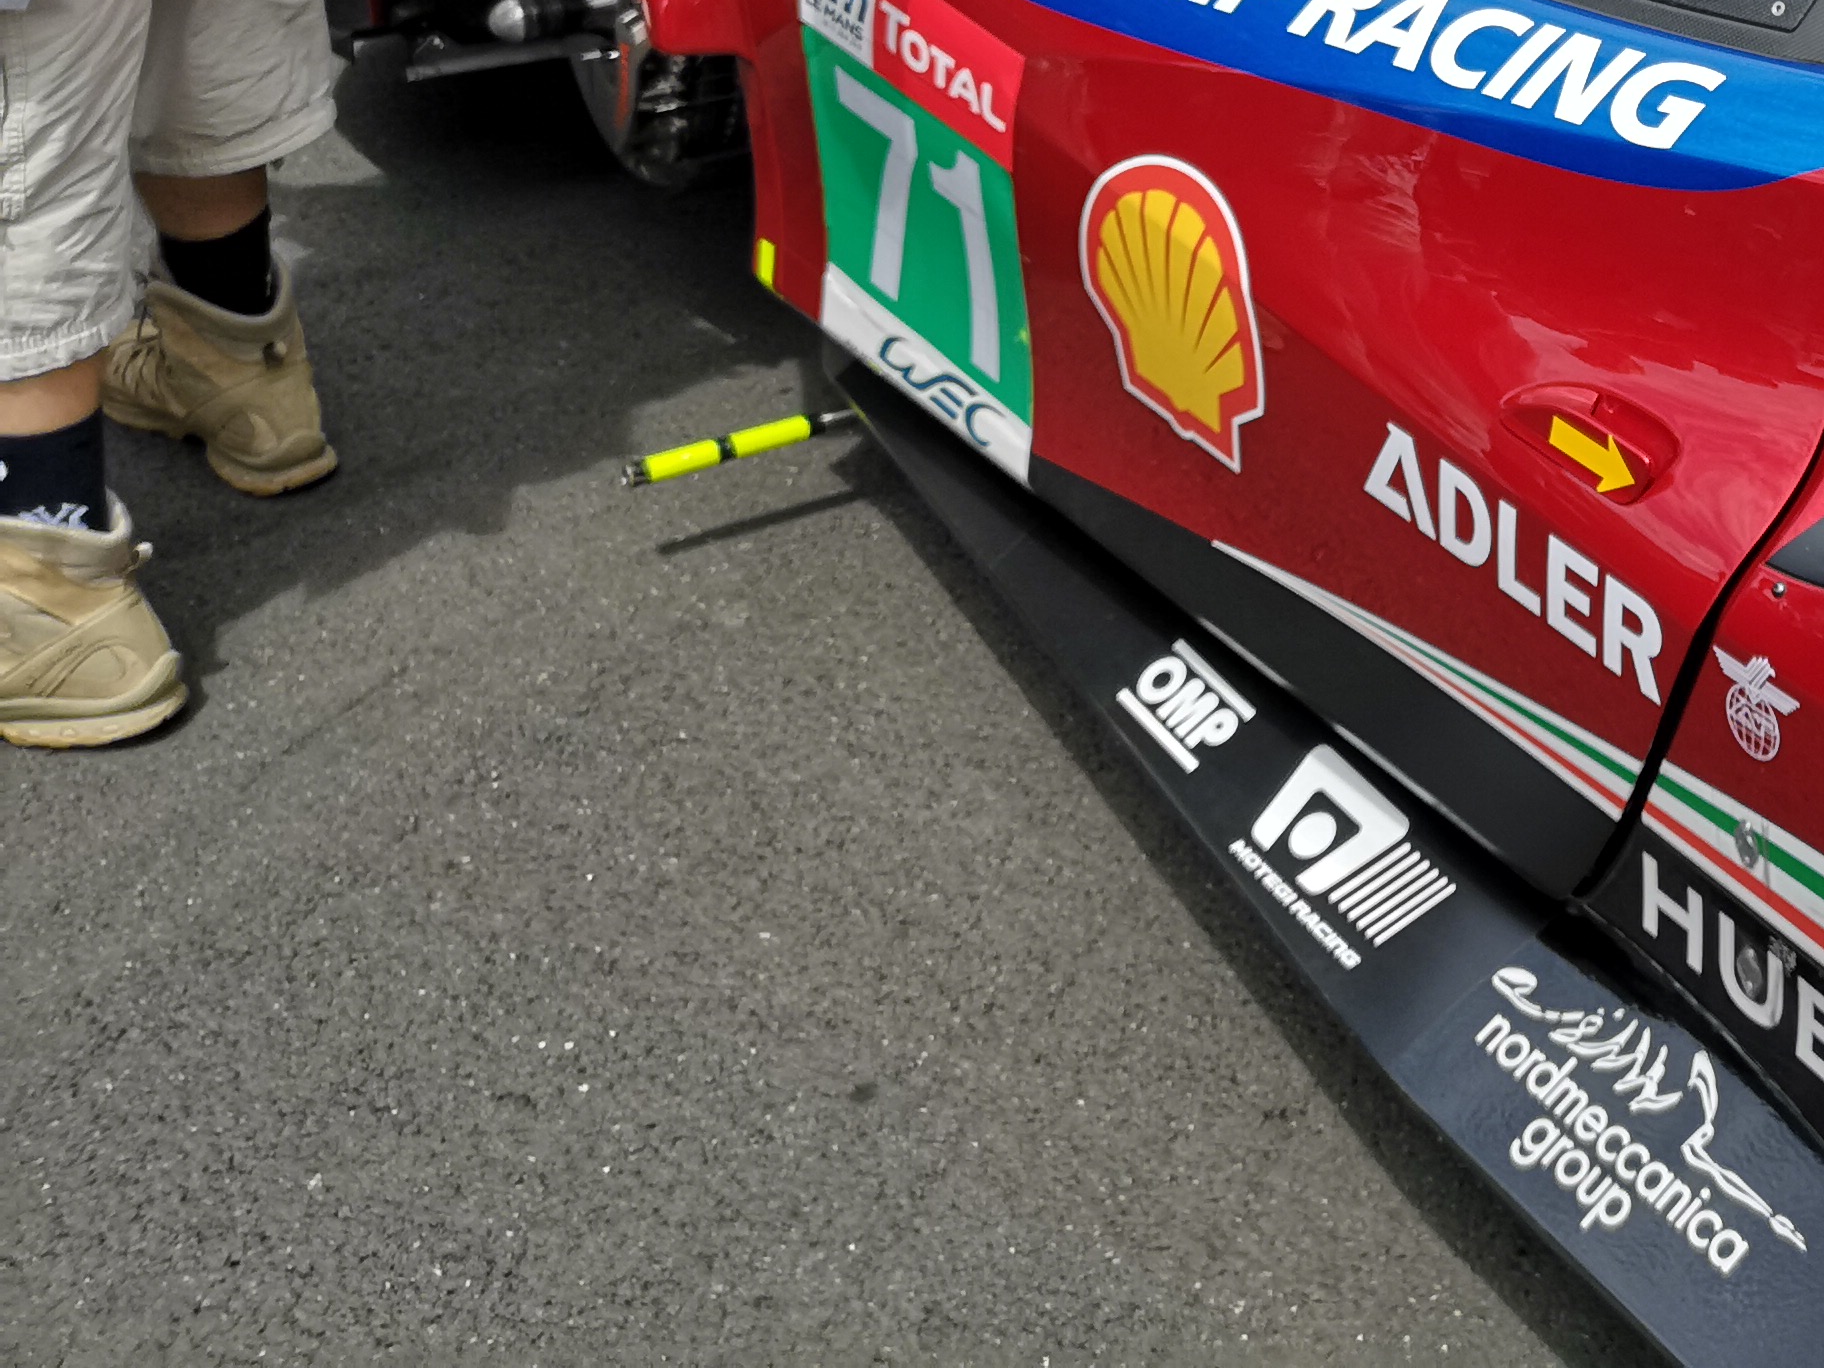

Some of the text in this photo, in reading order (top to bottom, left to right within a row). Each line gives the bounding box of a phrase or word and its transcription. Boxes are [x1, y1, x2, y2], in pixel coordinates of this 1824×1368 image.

[879, 0, 1006, 133] TOTAL
[835, 65, 1000, 384] 71
[879, 336, 1005, 448] WEC
[1363, 420, 1663, 707] ADLER
[1136, 655, 1240, 750] OMP
[1228, 837, 1362, 971] MOTEGI RACING
[1474, 1013, 1750, 1277] nordmeccanica
[1510, 1117, 1632, 1231] group
